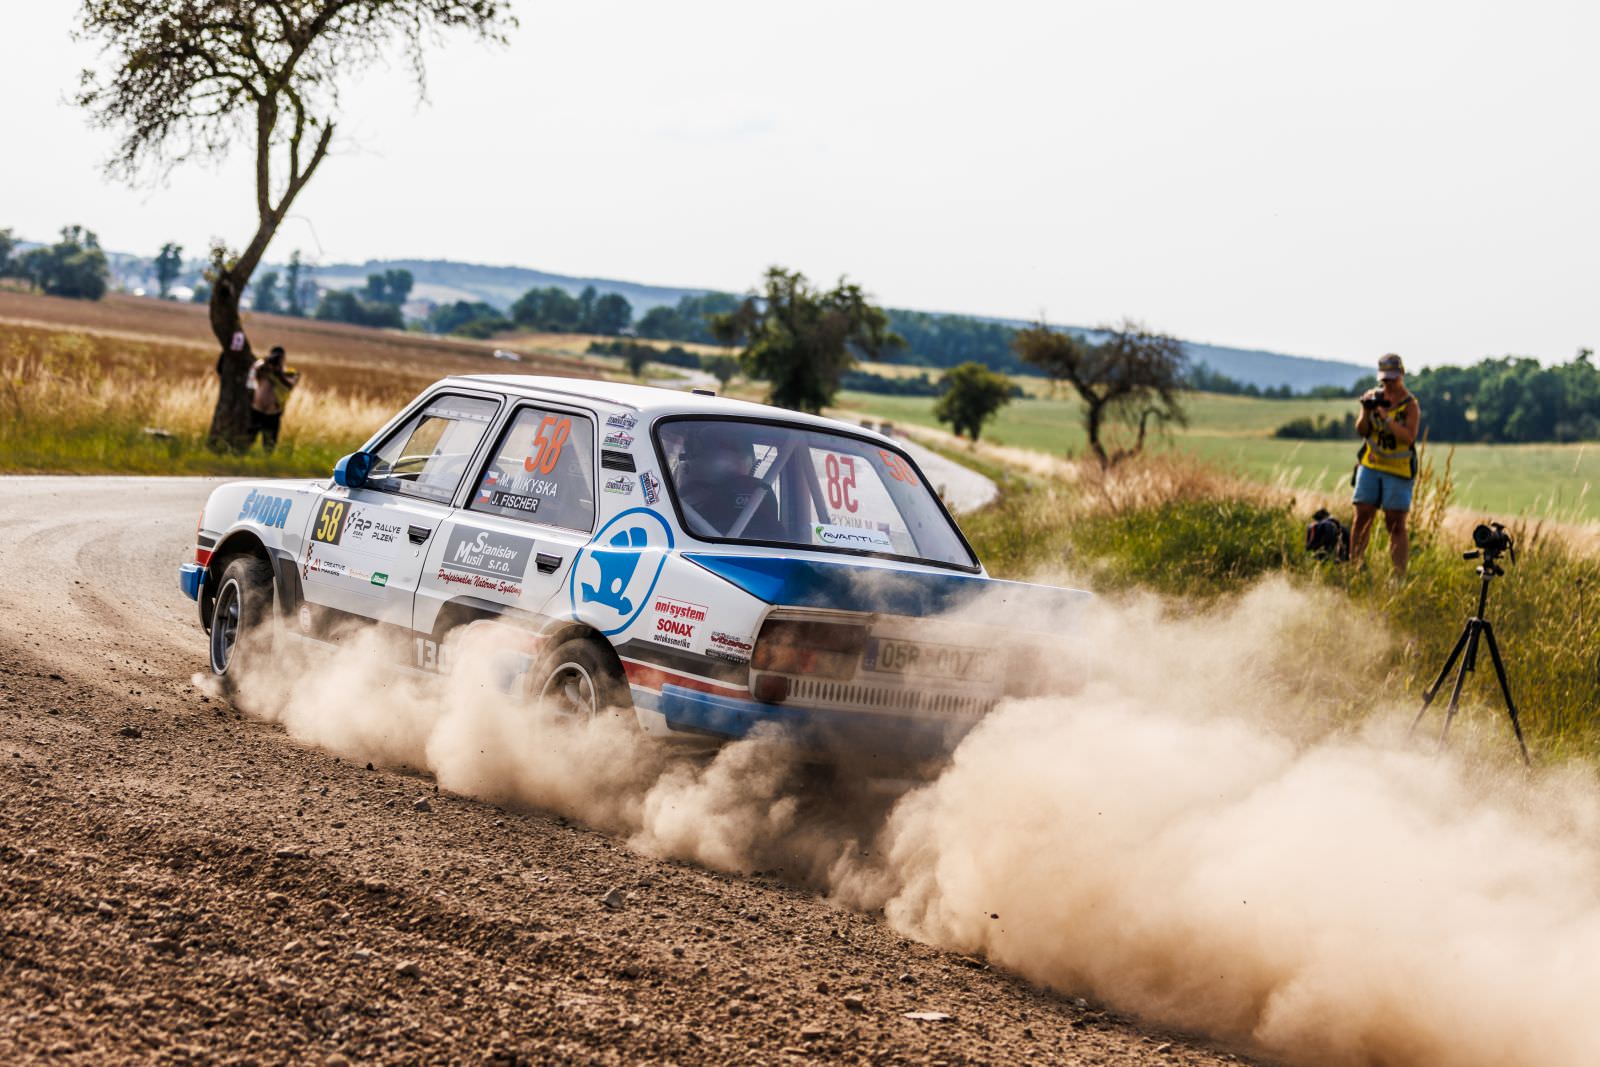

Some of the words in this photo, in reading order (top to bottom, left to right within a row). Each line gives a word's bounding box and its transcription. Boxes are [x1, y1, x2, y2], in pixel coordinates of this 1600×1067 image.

[525, 415, 571, 476] 58
[879, 450, 919, 487] 58
[499, 473, 509, 488] M.
[511, 477, 558, 497] MIKYSKA
[238, 488, 292, 529] ŠKODA
[491, 493, 499, 505] J.
[500, 495, 538, 511] FISCHER
[316, 500, 344, 542] 58
[354, 518, 372, 531] RP
[374, 522, 402, 534] RALLYE
[371, 531, 395, 543] PLZEŇ
[471, 531, 519, 560] Stanislav
[323, 560, 347, 571] CREATIVE
[453, 541, 484, 567] Musil
[487, 559, 510, 572] s.r.o.
[657, 618, 694, 637] SONAX
[653, 633, 691, 649] autokosmetika
